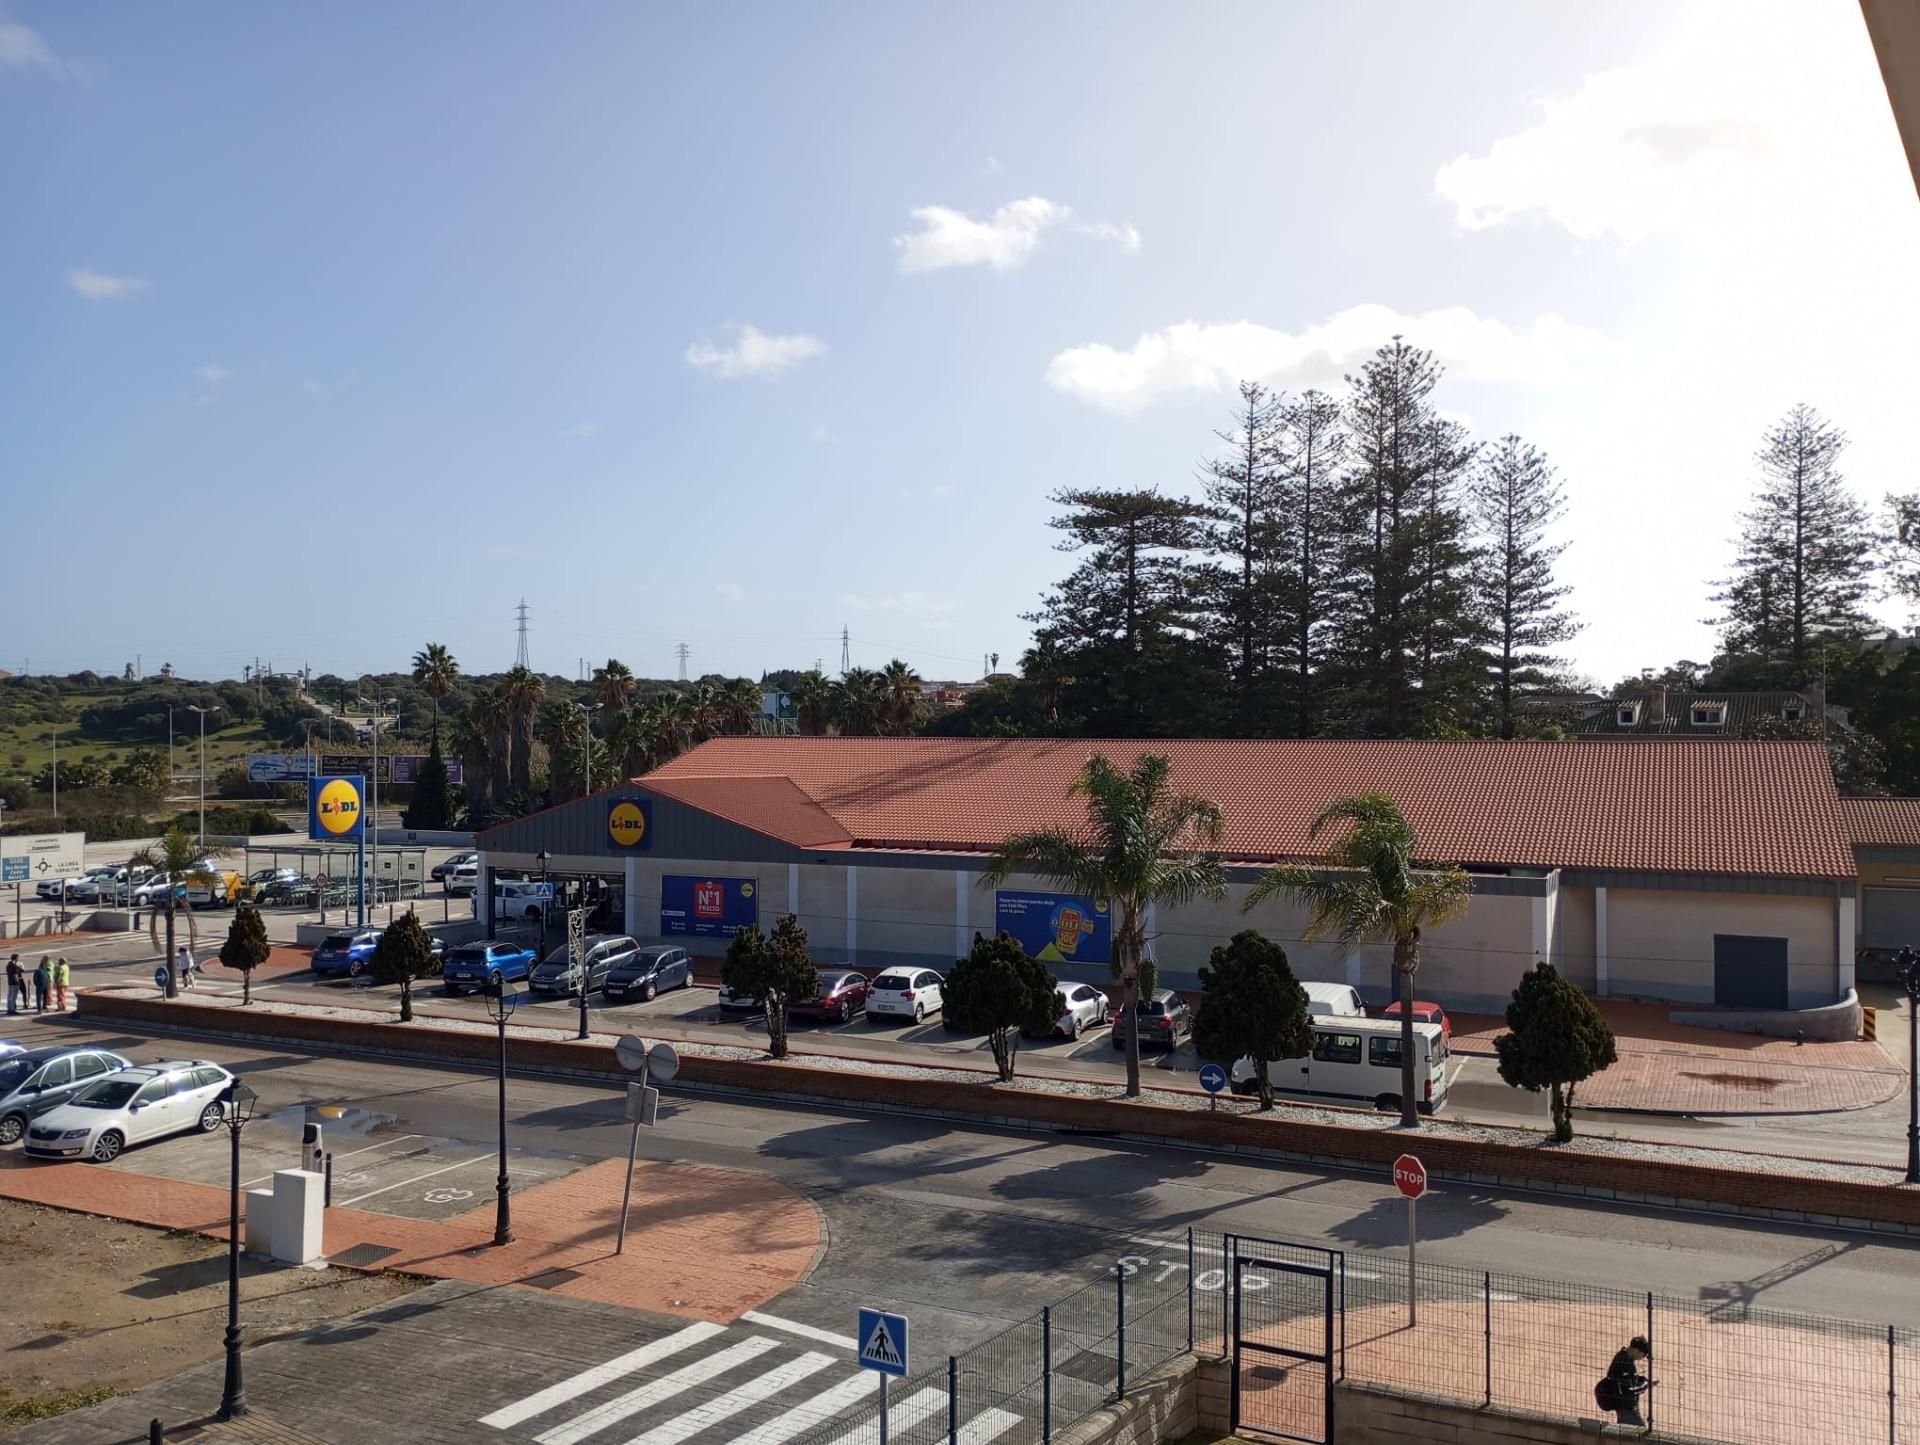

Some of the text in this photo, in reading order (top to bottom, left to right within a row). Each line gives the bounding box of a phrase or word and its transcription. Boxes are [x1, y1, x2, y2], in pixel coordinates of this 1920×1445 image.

[321, 798, 358, 814] LIDL
[611, 818, 642, 830] LIDL
[1395, 1169, 1424, 1185] STOP
